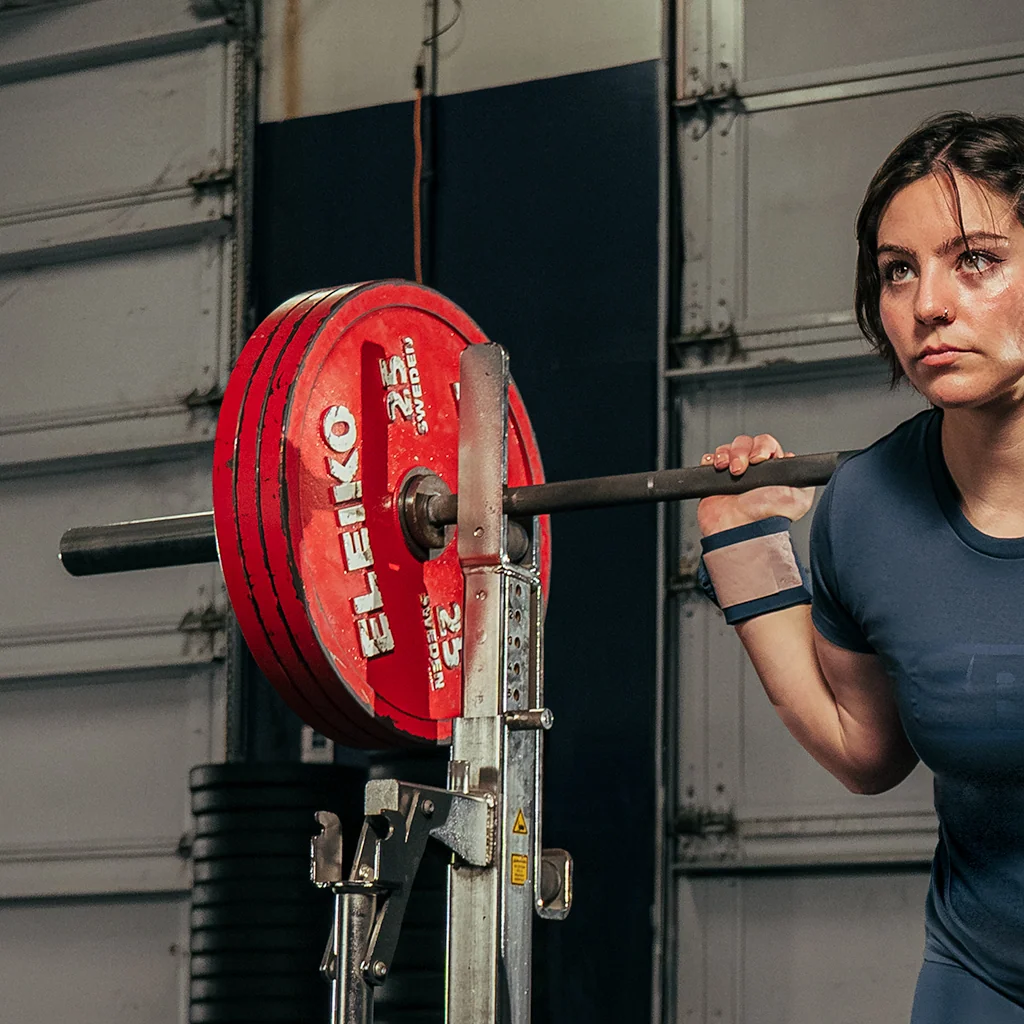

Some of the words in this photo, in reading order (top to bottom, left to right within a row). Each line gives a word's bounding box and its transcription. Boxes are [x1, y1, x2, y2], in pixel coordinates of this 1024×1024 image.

[379, 355, 414, 421] 25
[404, 337, 429, 434] SWEDEN
[322, 404, 395, 658] ELEIKO
[436, 602, 463, 669] 25
